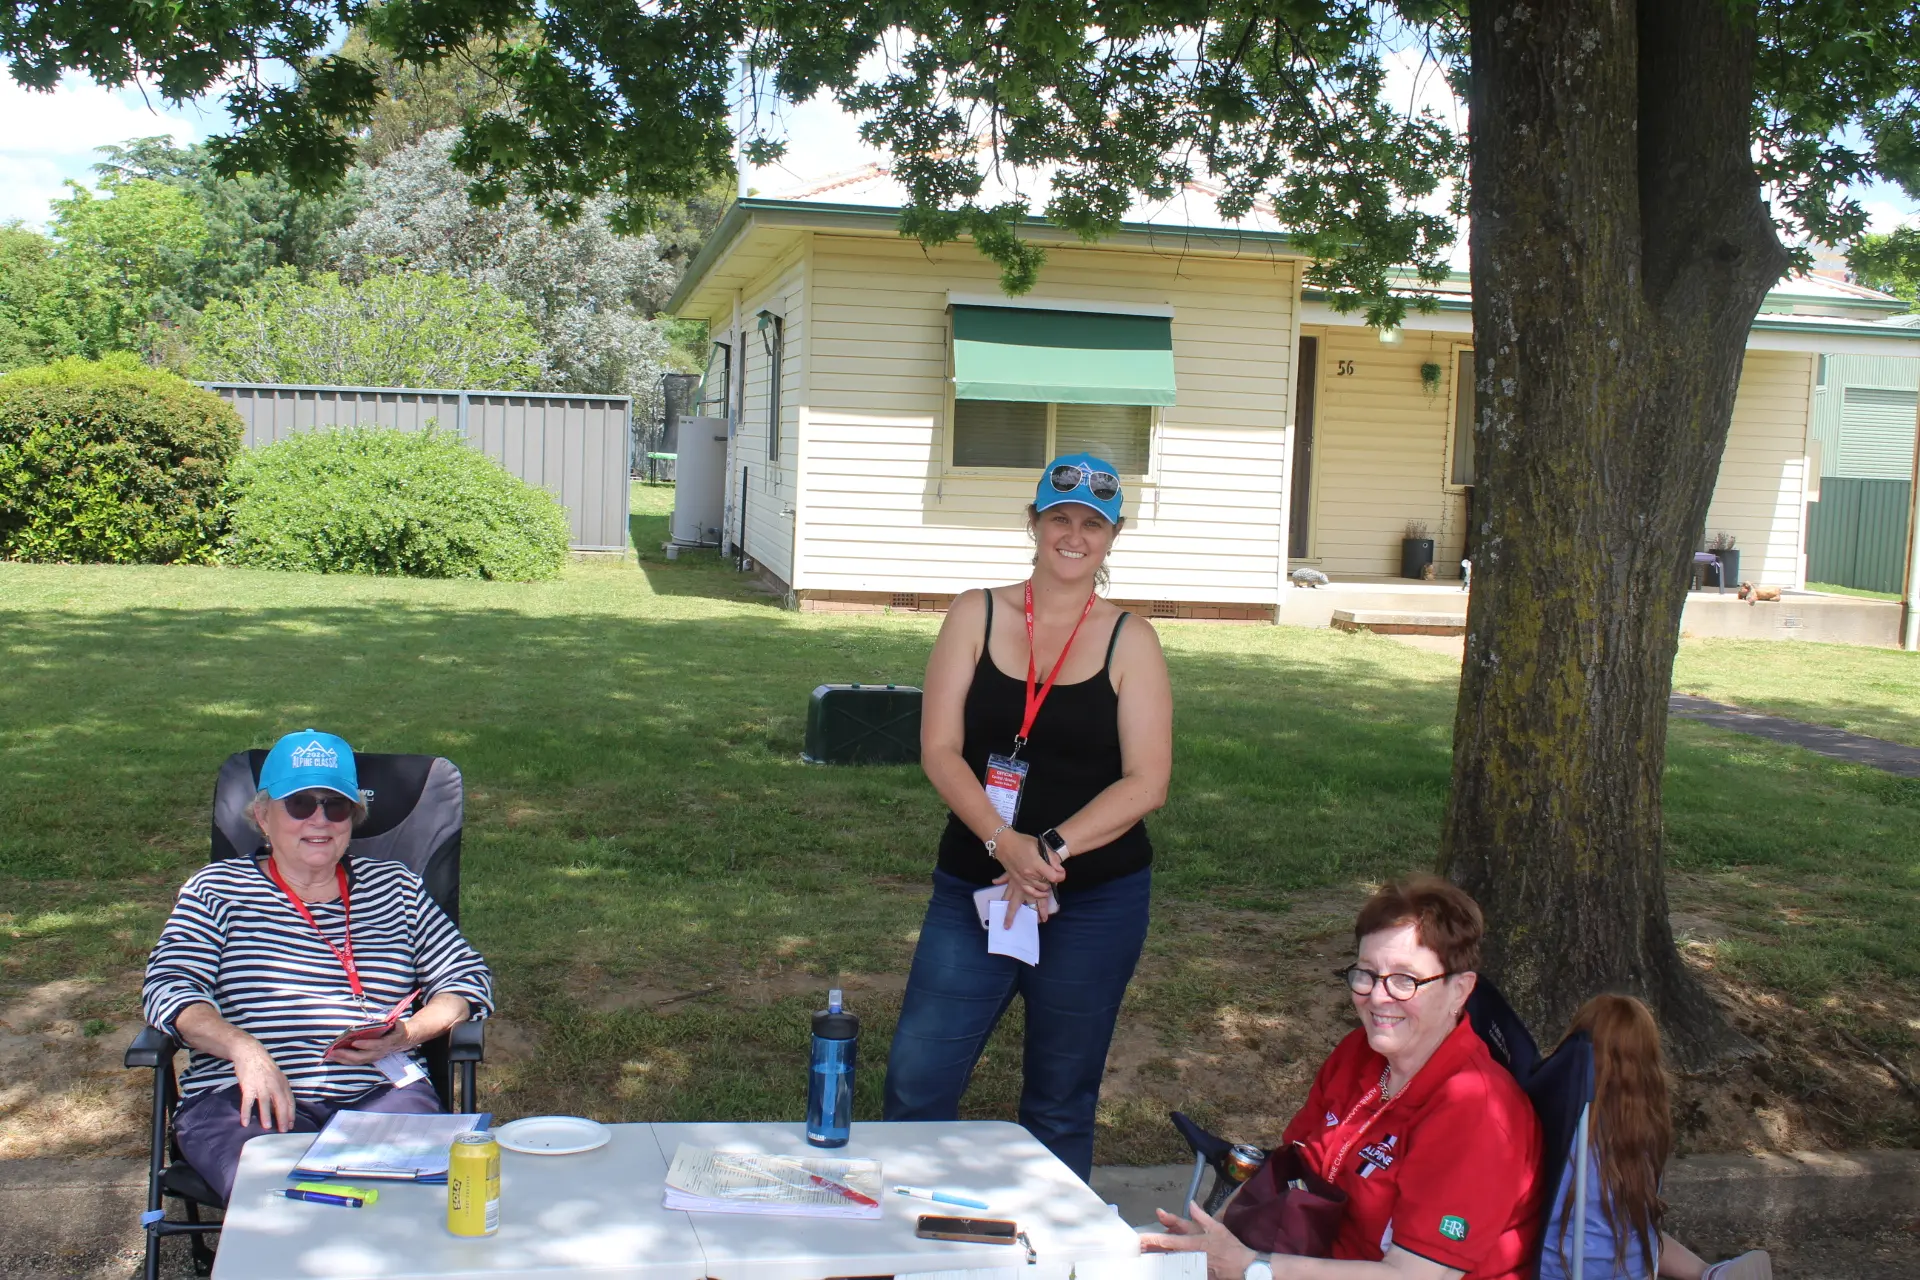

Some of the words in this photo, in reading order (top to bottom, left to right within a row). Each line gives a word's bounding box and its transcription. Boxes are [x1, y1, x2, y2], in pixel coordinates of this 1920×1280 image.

[1337, 360, 1354, 376] 56
[292, 756, 313, 768] ALPINE
[1362, 1144, 1394, 1167] ALPINE
[453, 1179, 461, 1209] SOLO
